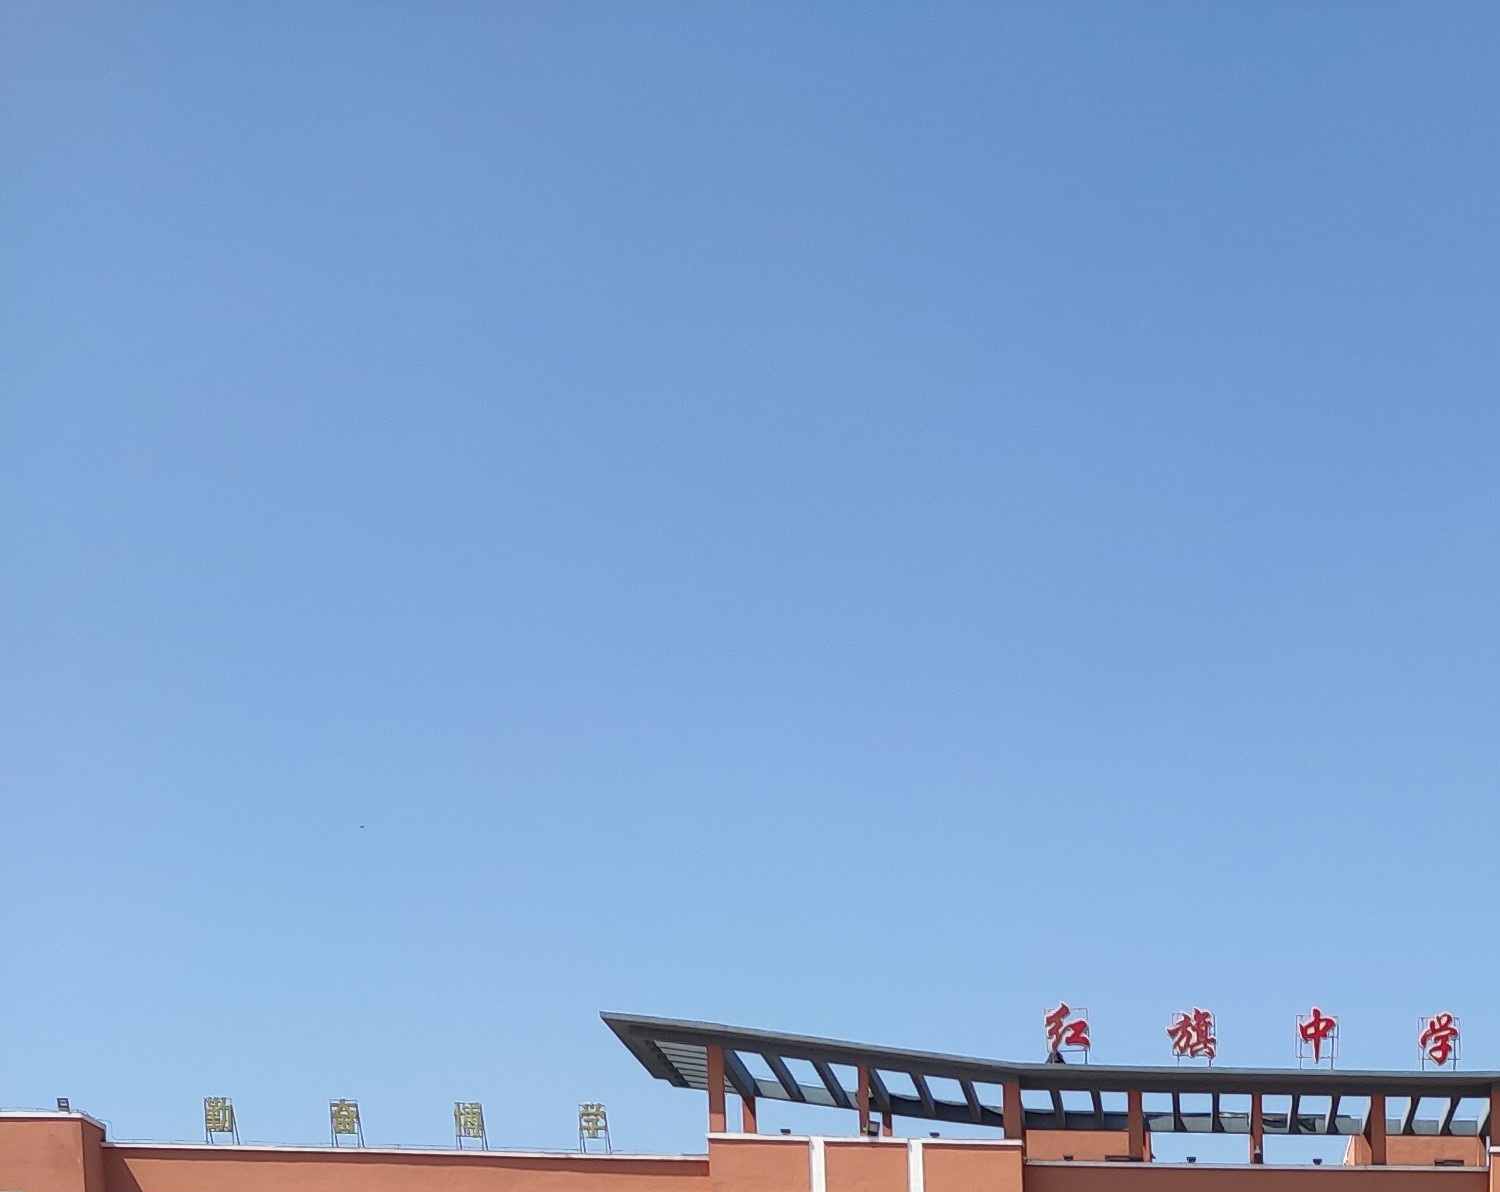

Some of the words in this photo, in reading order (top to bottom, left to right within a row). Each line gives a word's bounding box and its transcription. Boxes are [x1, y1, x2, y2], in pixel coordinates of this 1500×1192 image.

[1045, 1003, 1458, 1066] 红旗中学
[204, 1096, 607, 1139] 勤奋博学
